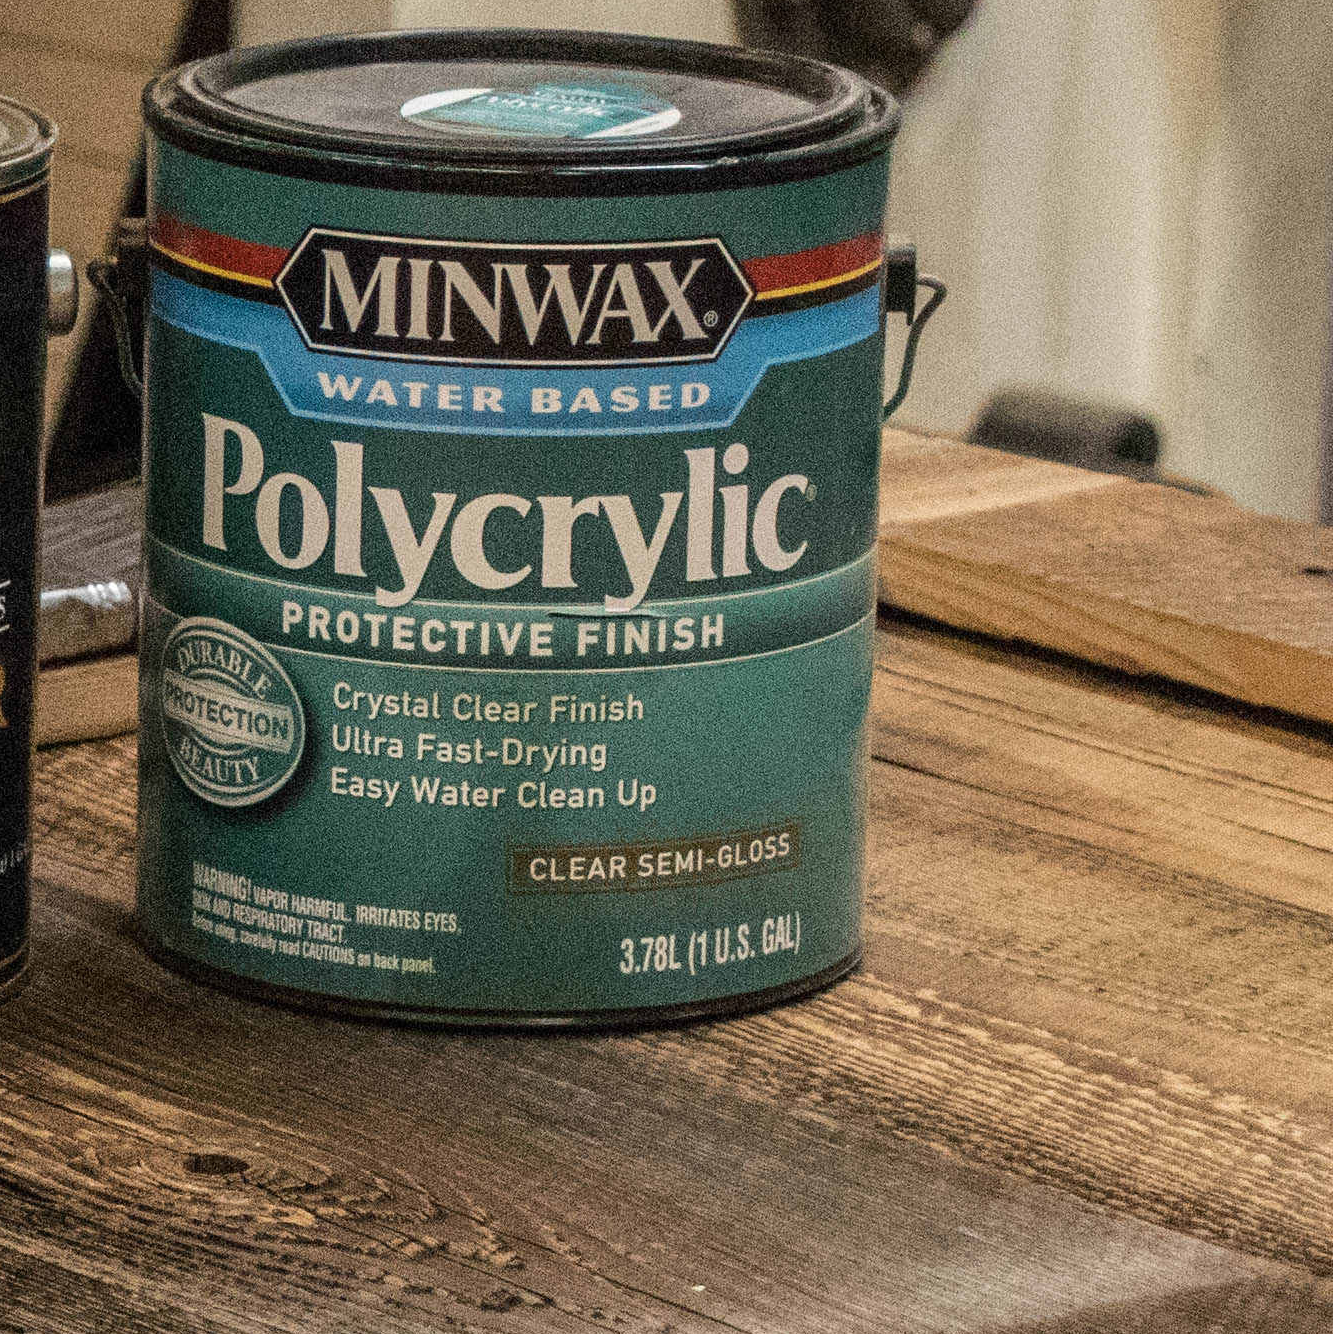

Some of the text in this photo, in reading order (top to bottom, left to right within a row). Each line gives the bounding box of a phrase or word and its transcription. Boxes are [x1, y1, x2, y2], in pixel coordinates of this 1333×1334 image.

[317, 371, 711, 414] WATER BASED
[201, 412, 809, 611] Polycrylic
[282, 602, 725, 657] PROTECTIVE FINISH
[177, 640, 272, 698] DURABLE
[165, 681, 289, 738] PROTECTION
[333, 683, 644, 724] Crystal Clear Finish
[179, 737, 260, 783] BEAUTY
[331, 724, 608, 773] Ultra Fast-Drying
[330, 768, 657, 813] Easy Water Clean Up
[529, 832, 791, 883] CLEAR SEMI-GLOSS
[192, 861, 252, 902] WARNING!
[253, 886, 289, 911] VAPOR
[356, 905, 421, 930] IRRITATES
[233, 902, 303, 937] RESPIRATORY
[302, 942, 354, 965] CAUTIONS
[374, 952, 399, 968] back
[619, 916, 803, 978] 3.78L (1 U.S. GAL)
